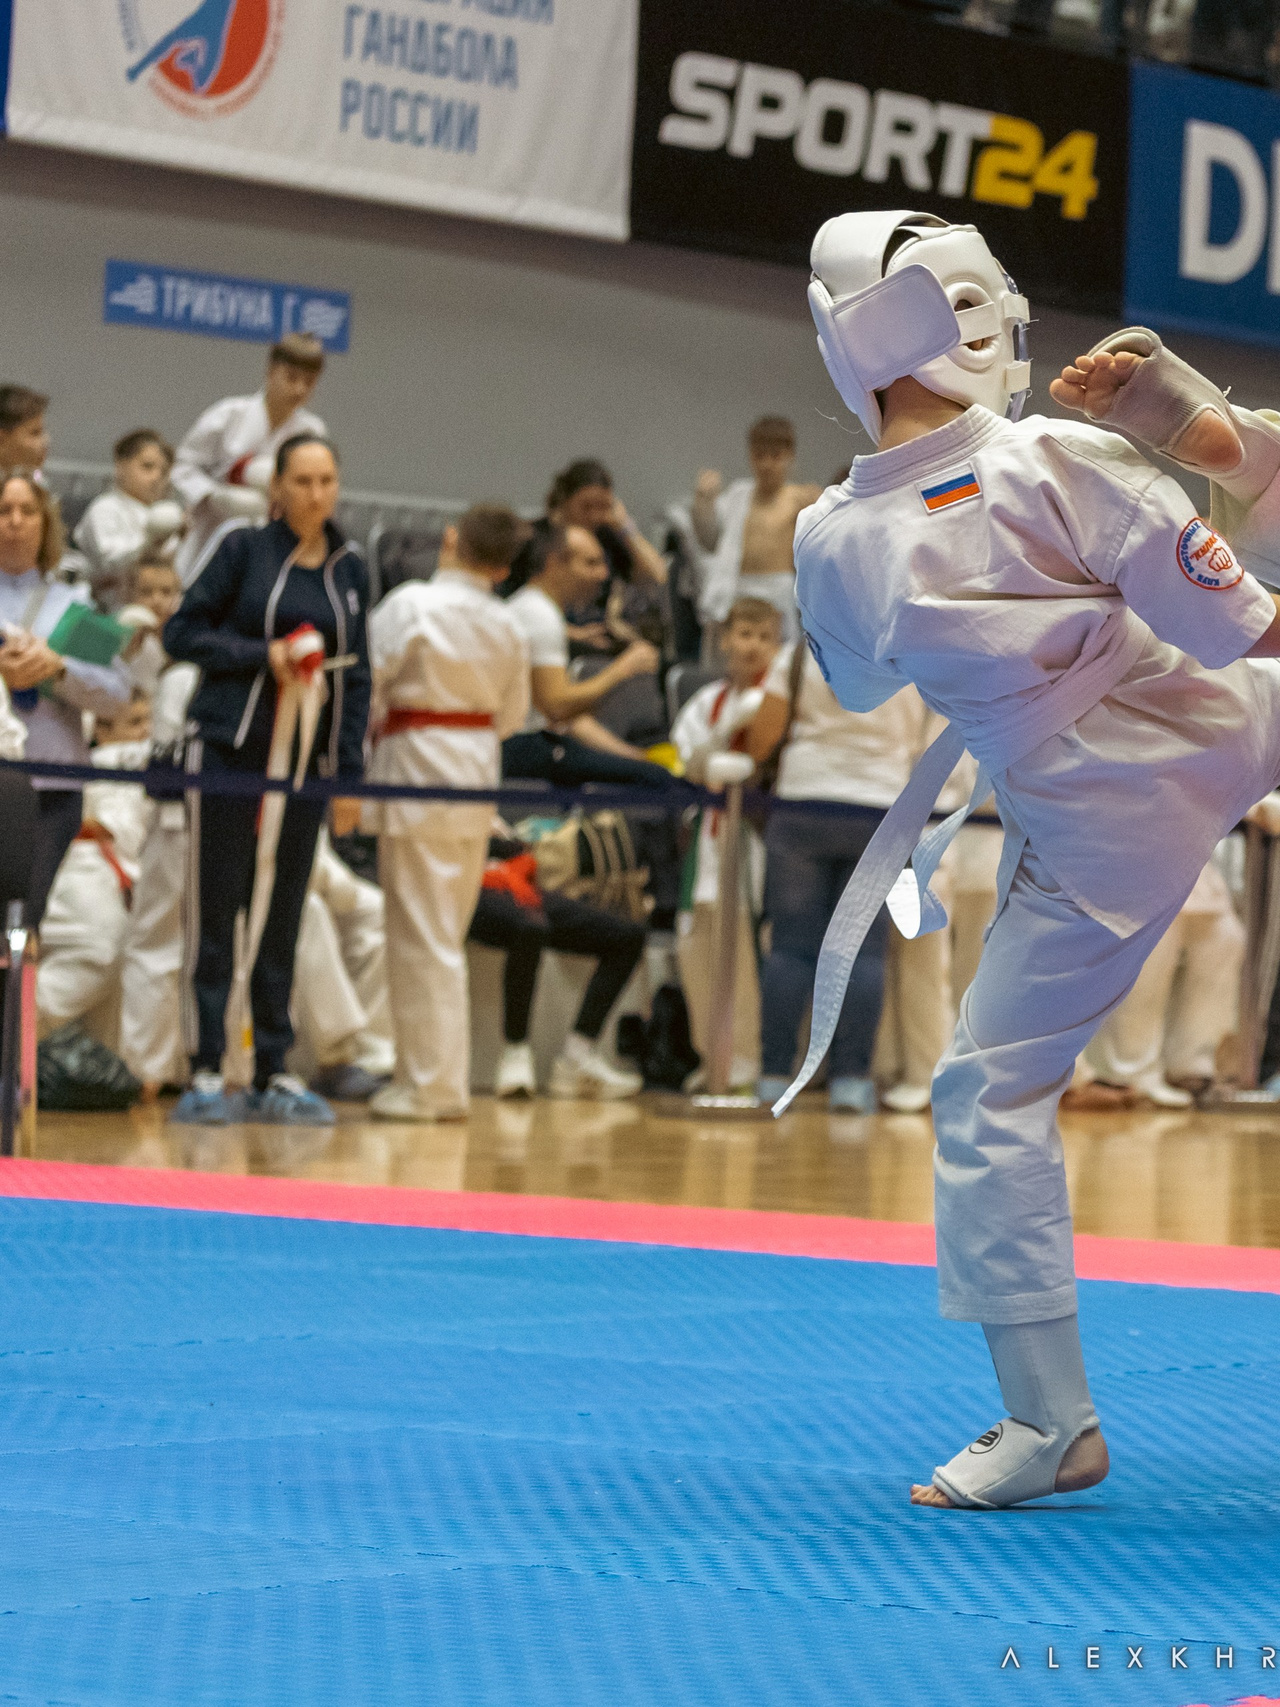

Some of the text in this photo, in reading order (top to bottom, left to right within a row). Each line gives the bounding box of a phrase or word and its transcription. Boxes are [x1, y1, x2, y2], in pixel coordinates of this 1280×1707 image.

[343, 3, 519, 91] ГАНДБОЛА
[339, 77, 480, 155] РОССИИ
[658, 50, 1099, 220] SPORT24
[1180, 521, 1219, 587] КЛУБ ВОСТОЧНЫХ
